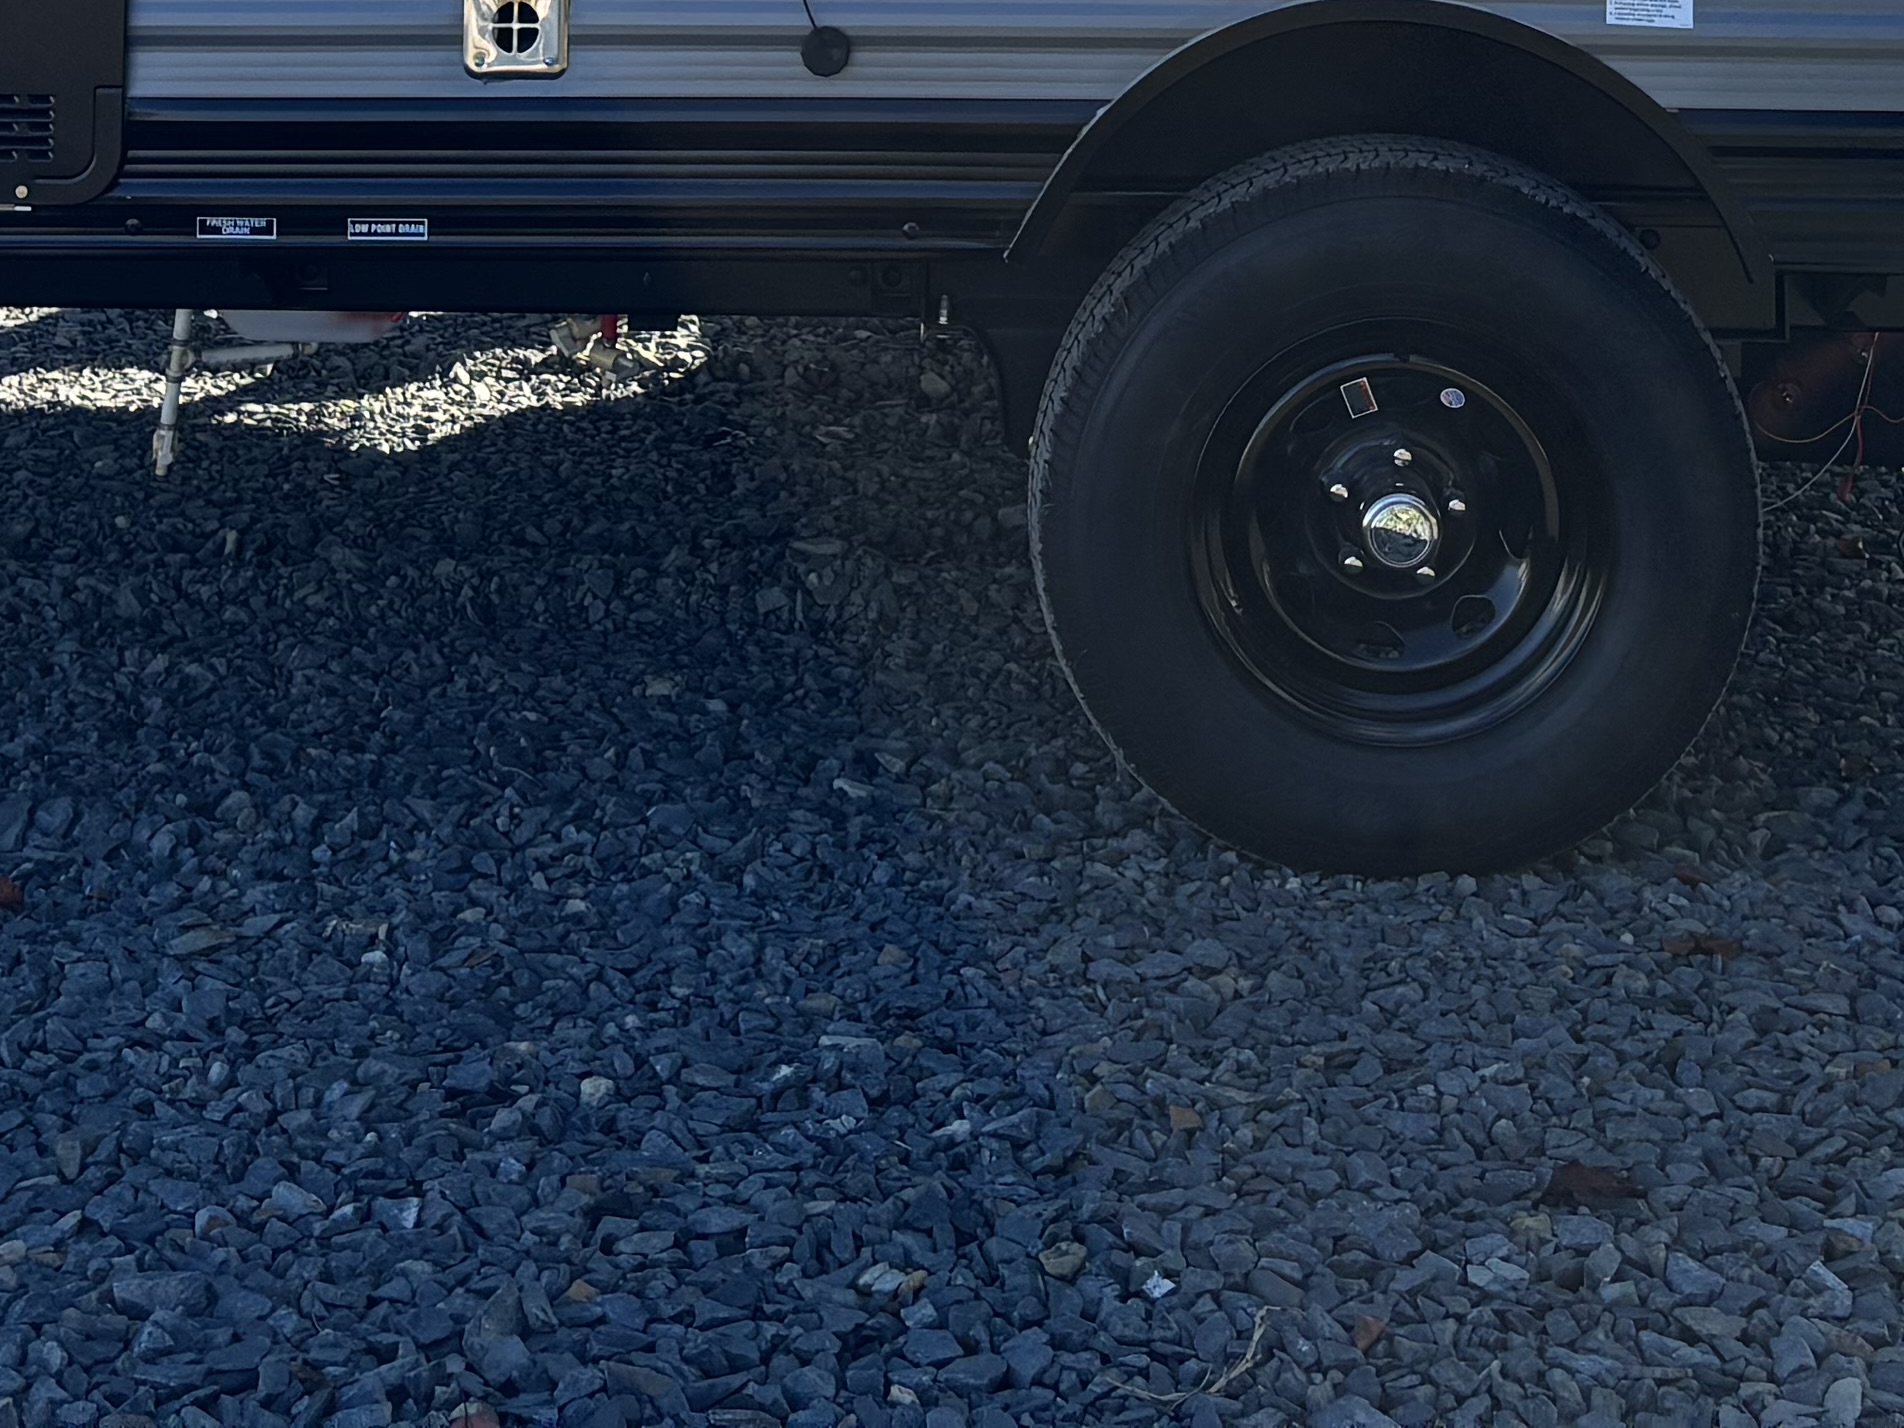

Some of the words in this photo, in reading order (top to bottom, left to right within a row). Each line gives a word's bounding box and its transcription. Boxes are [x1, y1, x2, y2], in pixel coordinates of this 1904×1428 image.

[206, 219, 235, 227] FRESH
[235, 219, 267, 228] WATER
[221, 226, 251, 235] DRAIN
[350, 223, 369, 234] LOW
[370, 223, 397, 234] POINT
[398, 223, 424, 234] DRAIN
